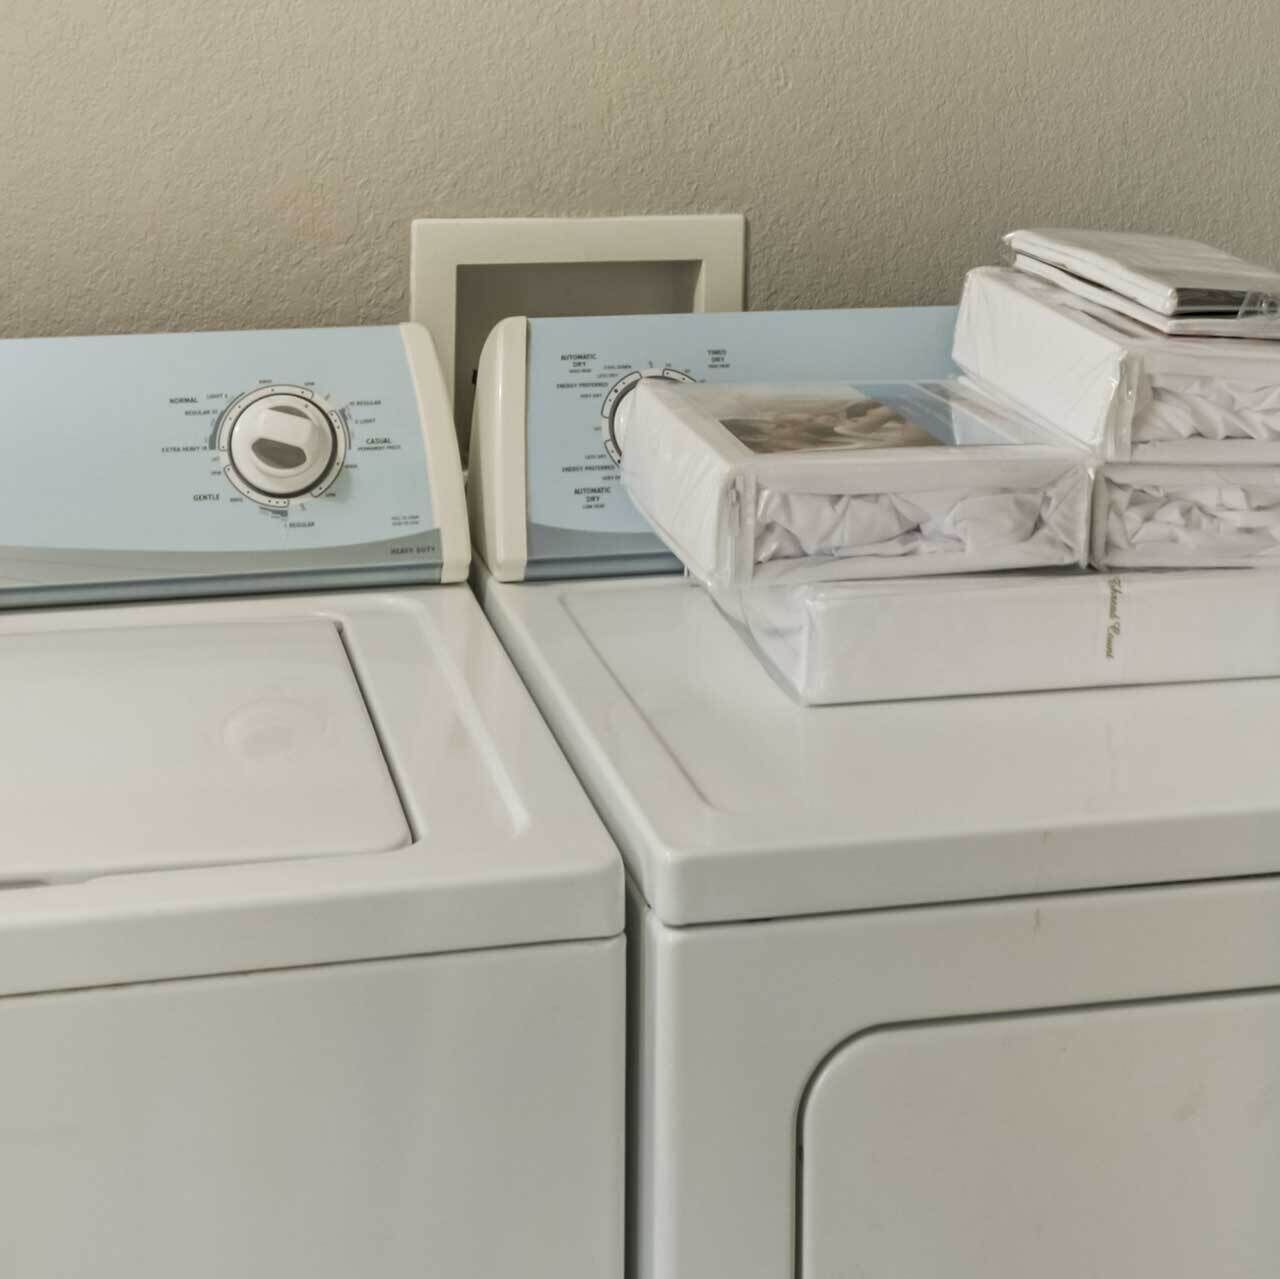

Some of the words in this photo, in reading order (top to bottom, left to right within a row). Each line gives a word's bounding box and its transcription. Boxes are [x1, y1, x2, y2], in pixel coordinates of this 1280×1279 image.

[560, 353, 597, 361] AUTOMATIC
[711, 356, 726, 364] DRY
[556, 382, 578, 390] ENERGY
[366, 437, 392, 445] CASUAL
[574, 487, 611, 495] AUTOMATIC
[193, 493, 220, 502] GENTLE
[389, 546, 414, 555] HEAVY
[416, 545, 436, 554] DUTY
